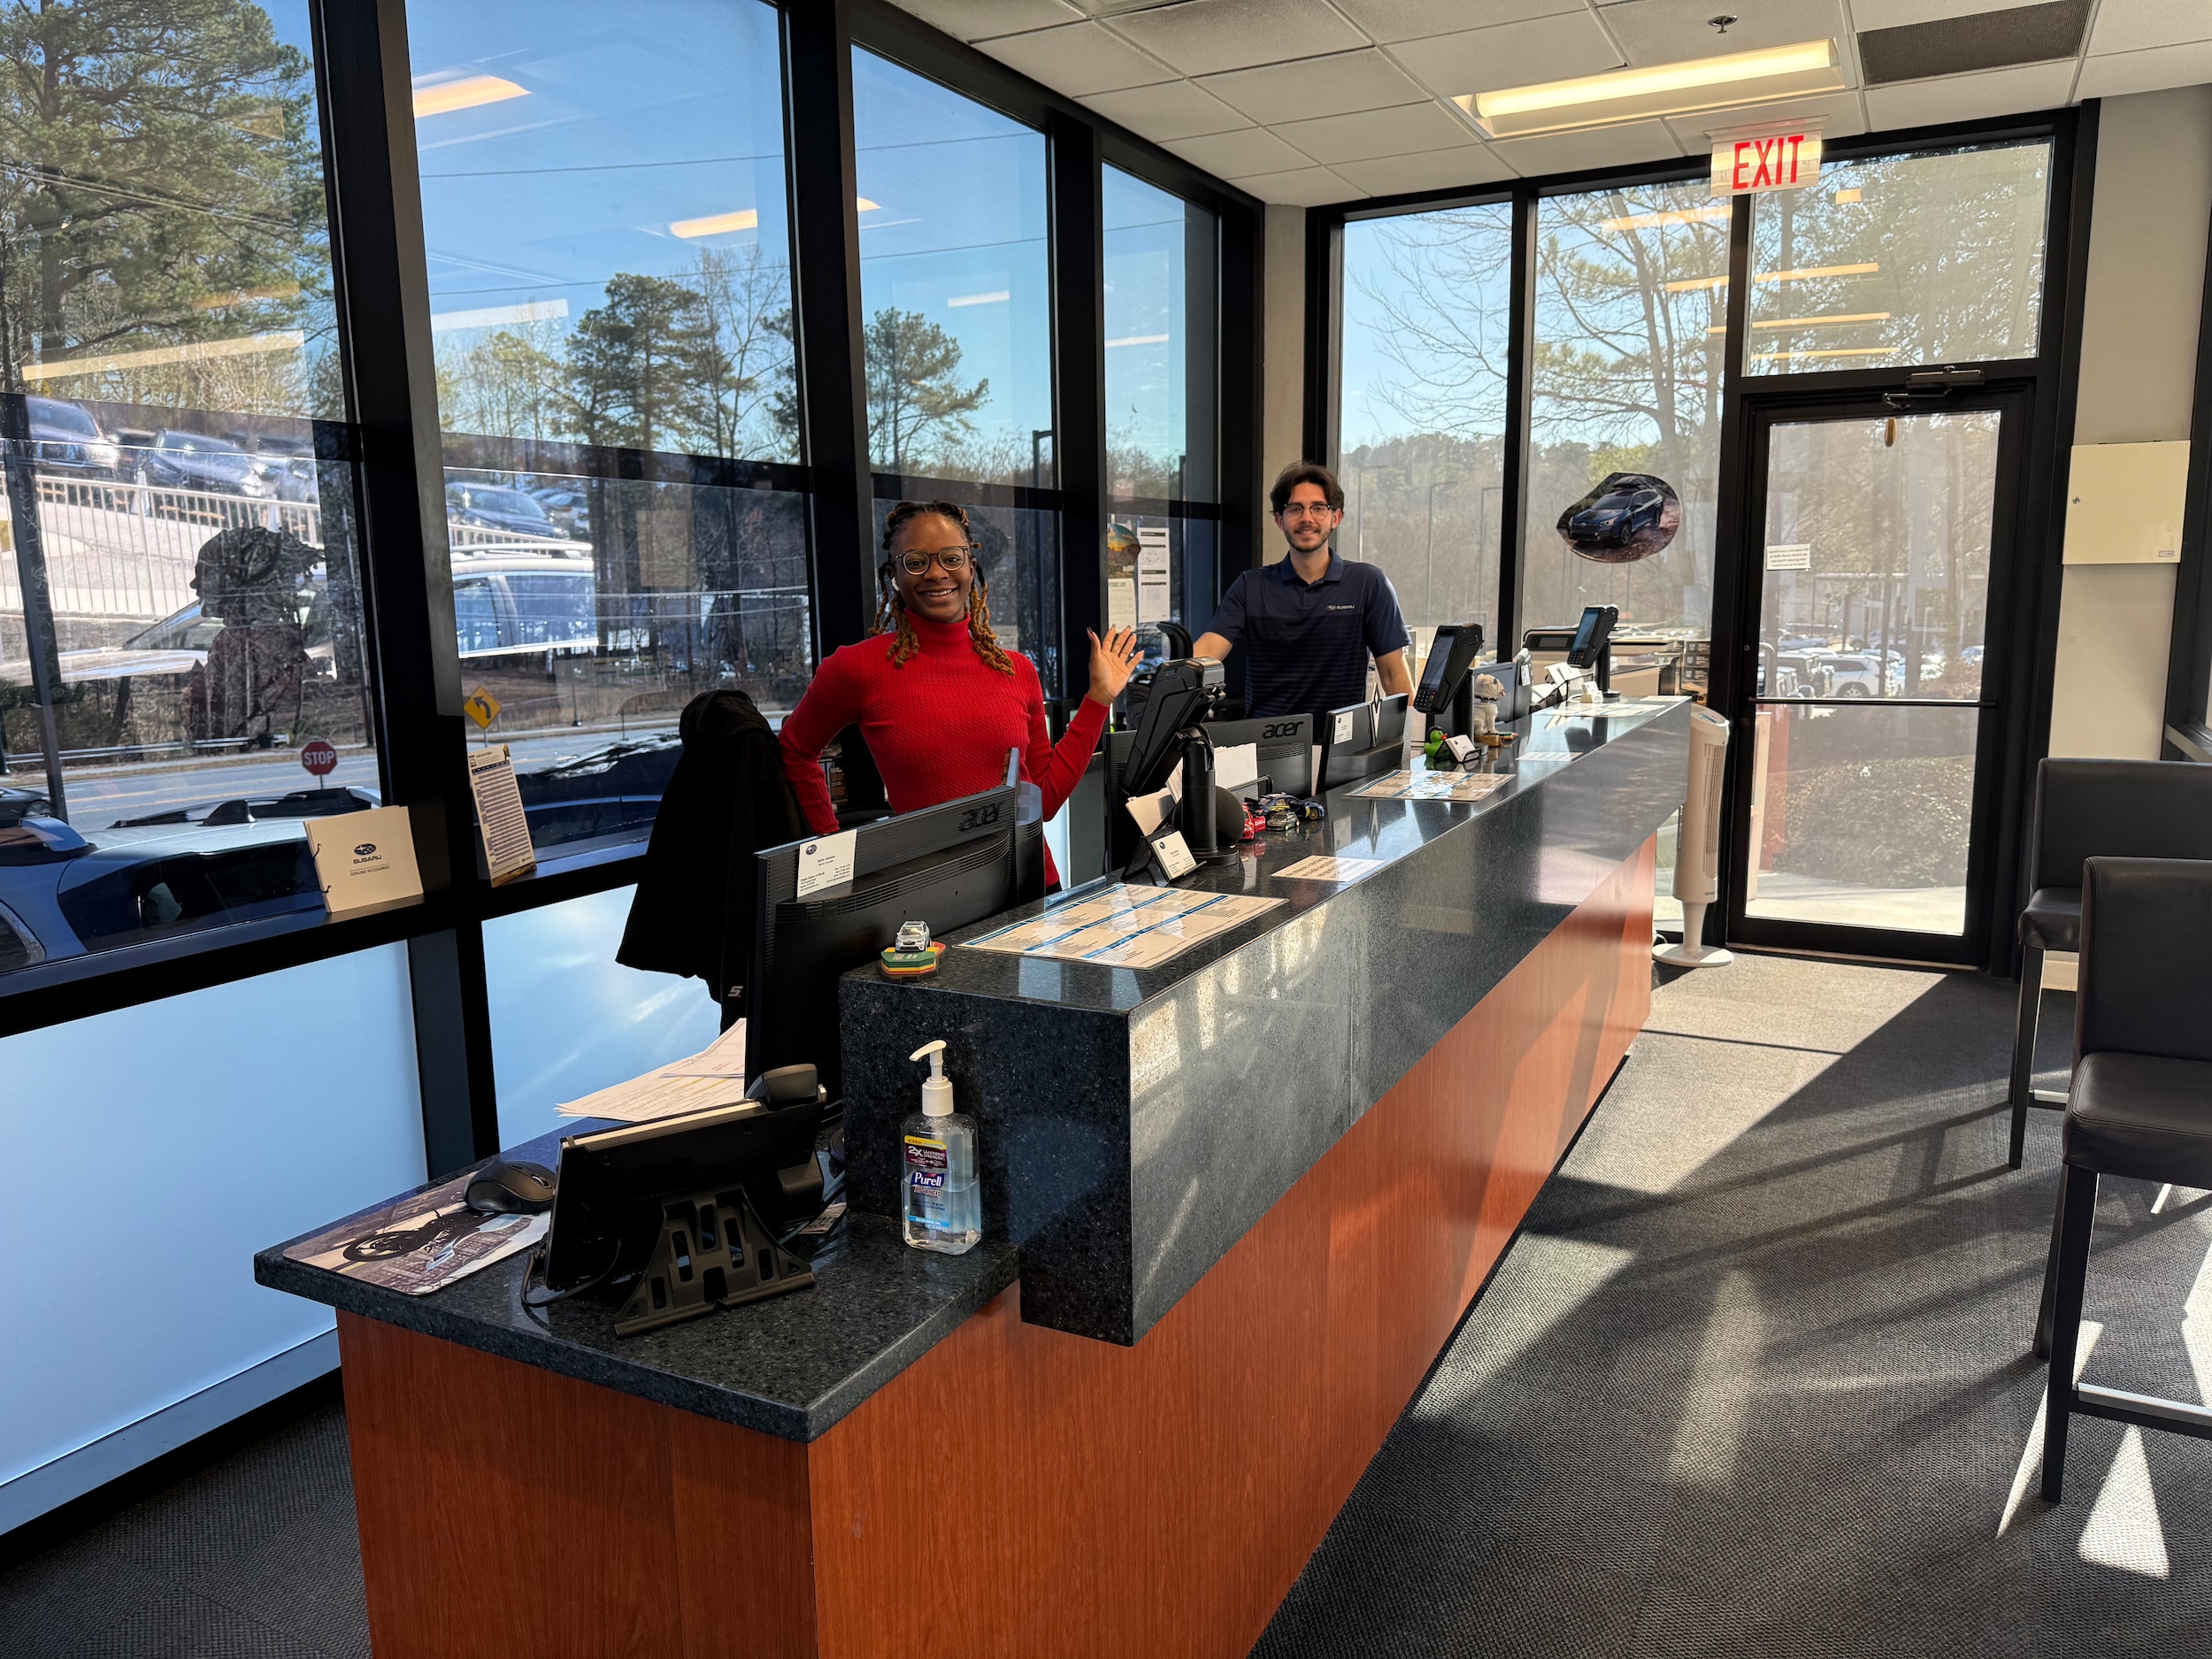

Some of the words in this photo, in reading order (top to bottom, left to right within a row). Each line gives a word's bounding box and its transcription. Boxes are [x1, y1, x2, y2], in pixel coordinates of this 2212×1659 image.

[1732, 134, 1804, 189] EXIT
[1262, 720, 1304, 739] acer
[303, 750, 334, 766] STOP
[958, 801, 1003, 832] acer
[353, 855, 382, 864] SUBARU
[908, 1145, 924, 1157] 2X
[914, 1171, 942, 1187] Purell
